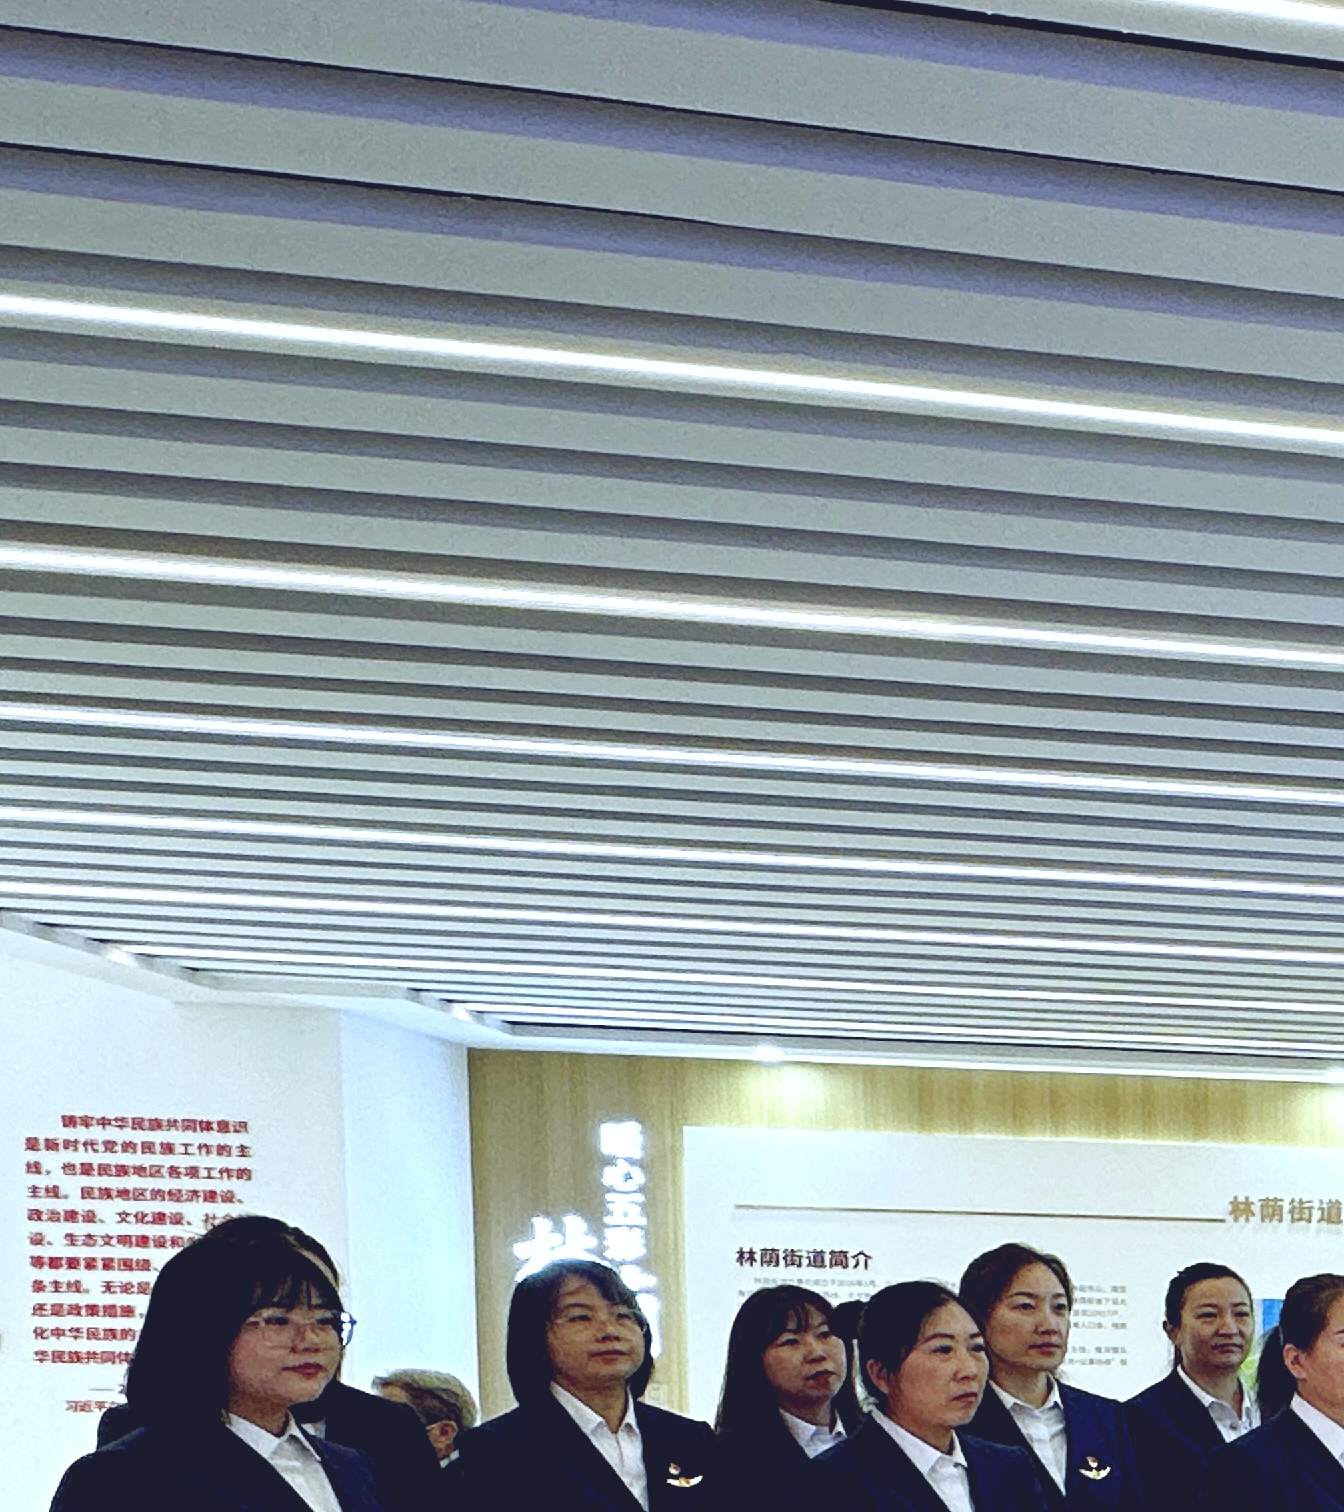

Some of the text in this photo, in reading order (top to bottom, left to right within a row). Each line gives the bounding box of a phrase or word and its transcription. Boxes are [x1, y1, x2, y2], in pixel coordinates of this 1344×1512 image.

[25, 1137, 253, 1158] 是新时代党的民族工作的主
[735, 1246, 873, 1270] 林荫街道简介
